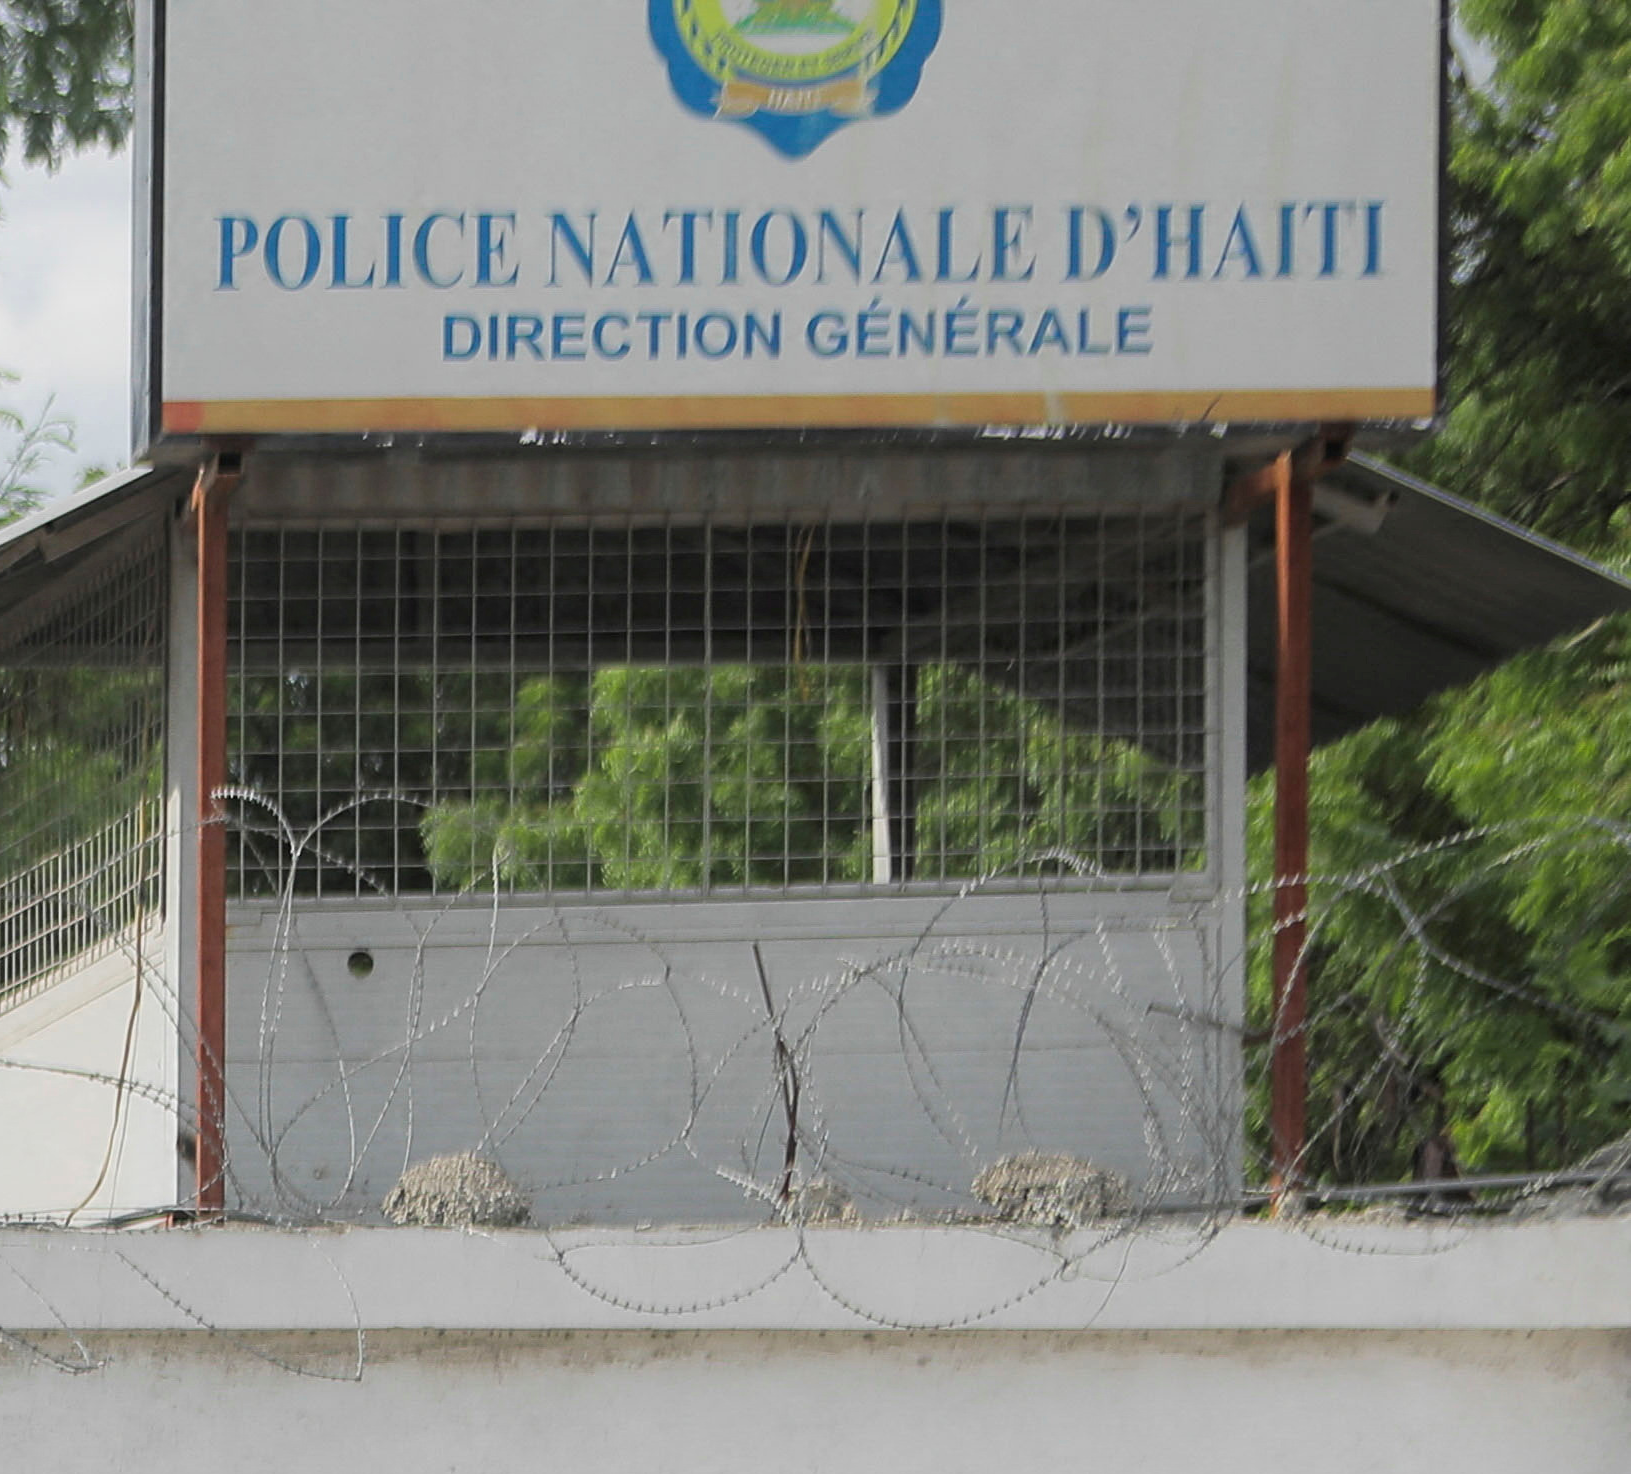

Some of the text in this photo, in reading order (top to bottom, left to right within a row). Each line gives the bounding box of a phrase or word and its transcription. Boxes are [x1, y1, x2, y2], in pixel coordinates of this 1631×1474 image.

[212, 199, 1385, 292] POLICE NATIONALE D'HAITI
[442, 294, 1155, 362] DIRECTION GÉNÉRALE
